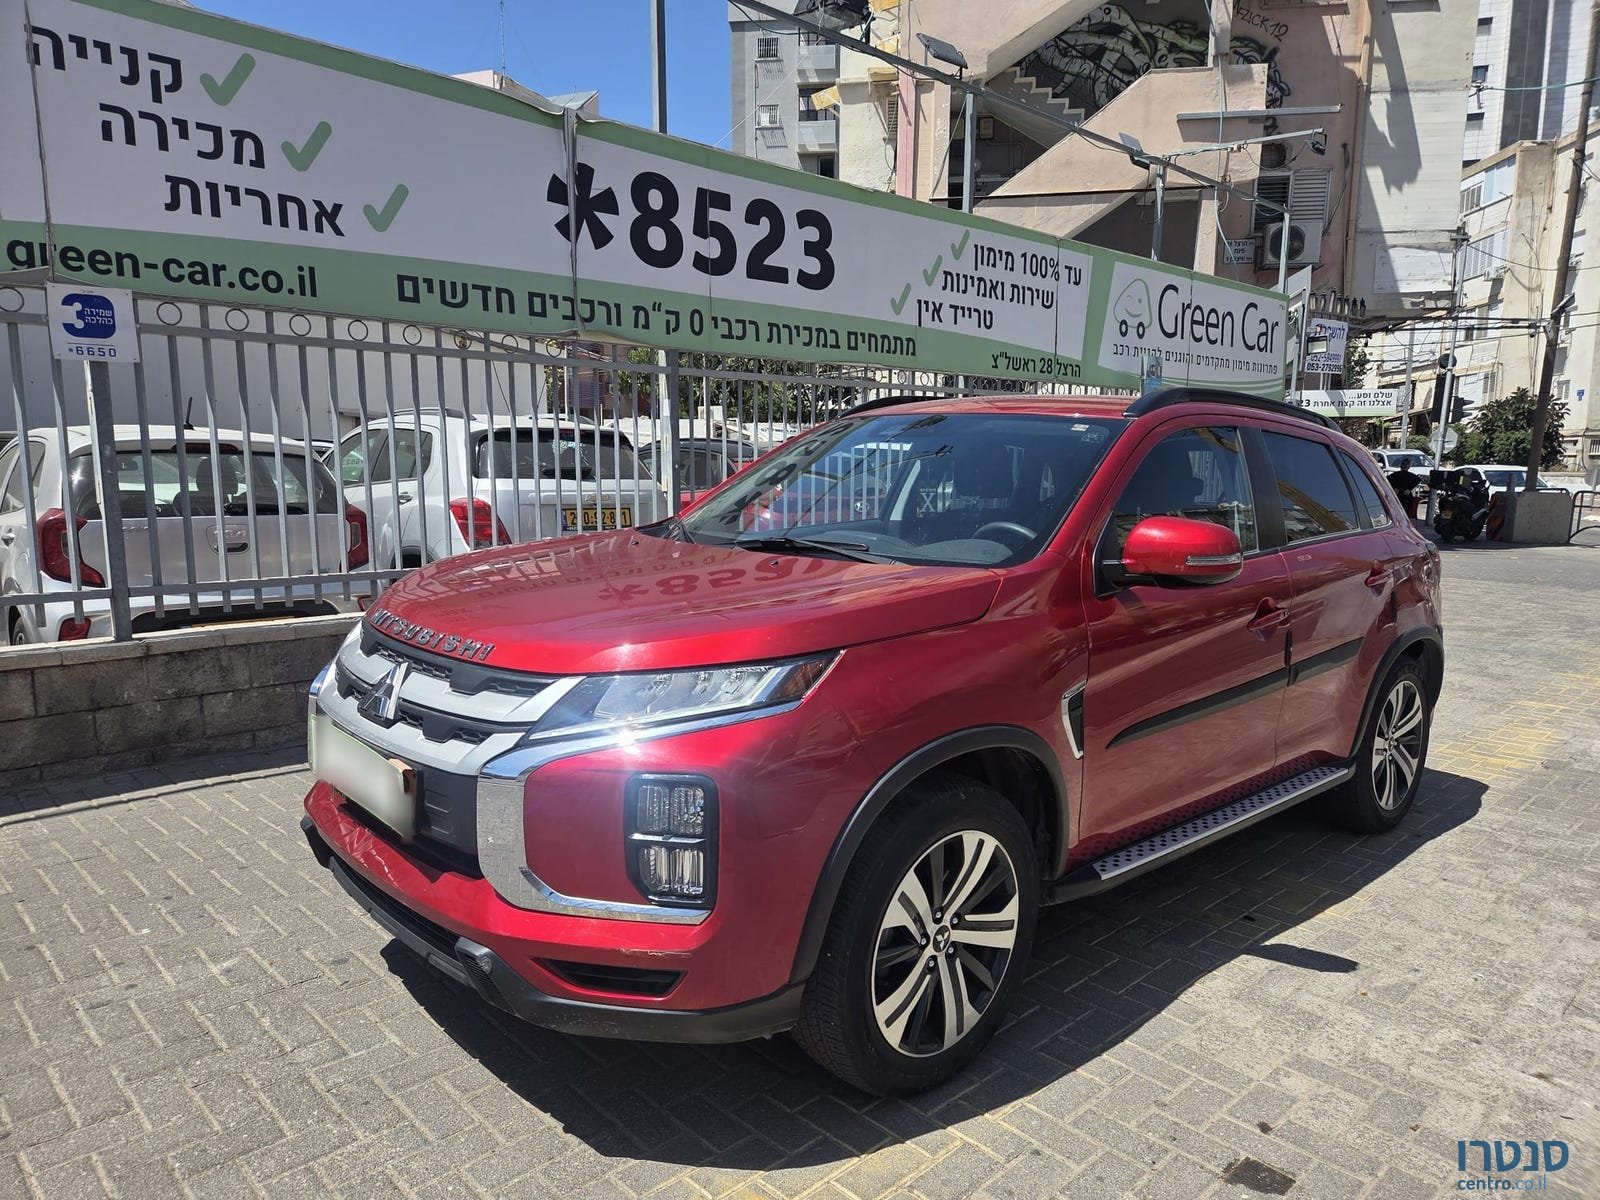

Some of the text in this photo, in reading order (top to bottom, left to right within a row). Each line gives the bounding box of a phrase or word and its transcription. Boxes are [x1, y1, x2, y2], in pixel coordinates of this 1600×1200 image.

[30, 25, 183, 104] קנייה
[99, 102, 266, 169] מכירה
[164, 174, 346, 237] אחריות
[6, 239, 318, 298] green-car.co.il
[974, 243, 1082, 286] עד 100% מימון
[396, 273, 516, 315] חדשים
[941, 269, 1055, 309] שירות ואמינות
[84, 307, 113, 317] שמירה
[527, 290, 622, 328] ורכבים
[916, 298, 994, 330] טרייד אין
[1158, 283, 1279, 354] Green Car
[711, 316, 760, 343] רכבי
[767, 321, 841, 350] במכירת
[847, 330, 917, 357] מתמחים
[1113, 343, 1130, 357] רכב
[1039, 357, 1053, 375] 28
[1055, 359, 1082, 378] הרצל
[1313, 400, 1336, 408] אחרת
[1357, 399, 1366, 407] זה
[1368, 399, 1393, 407] אצלנו
[1374, 391, 1393, 399] שלם
[370, 608, 496, 661] MITSUBISHI
